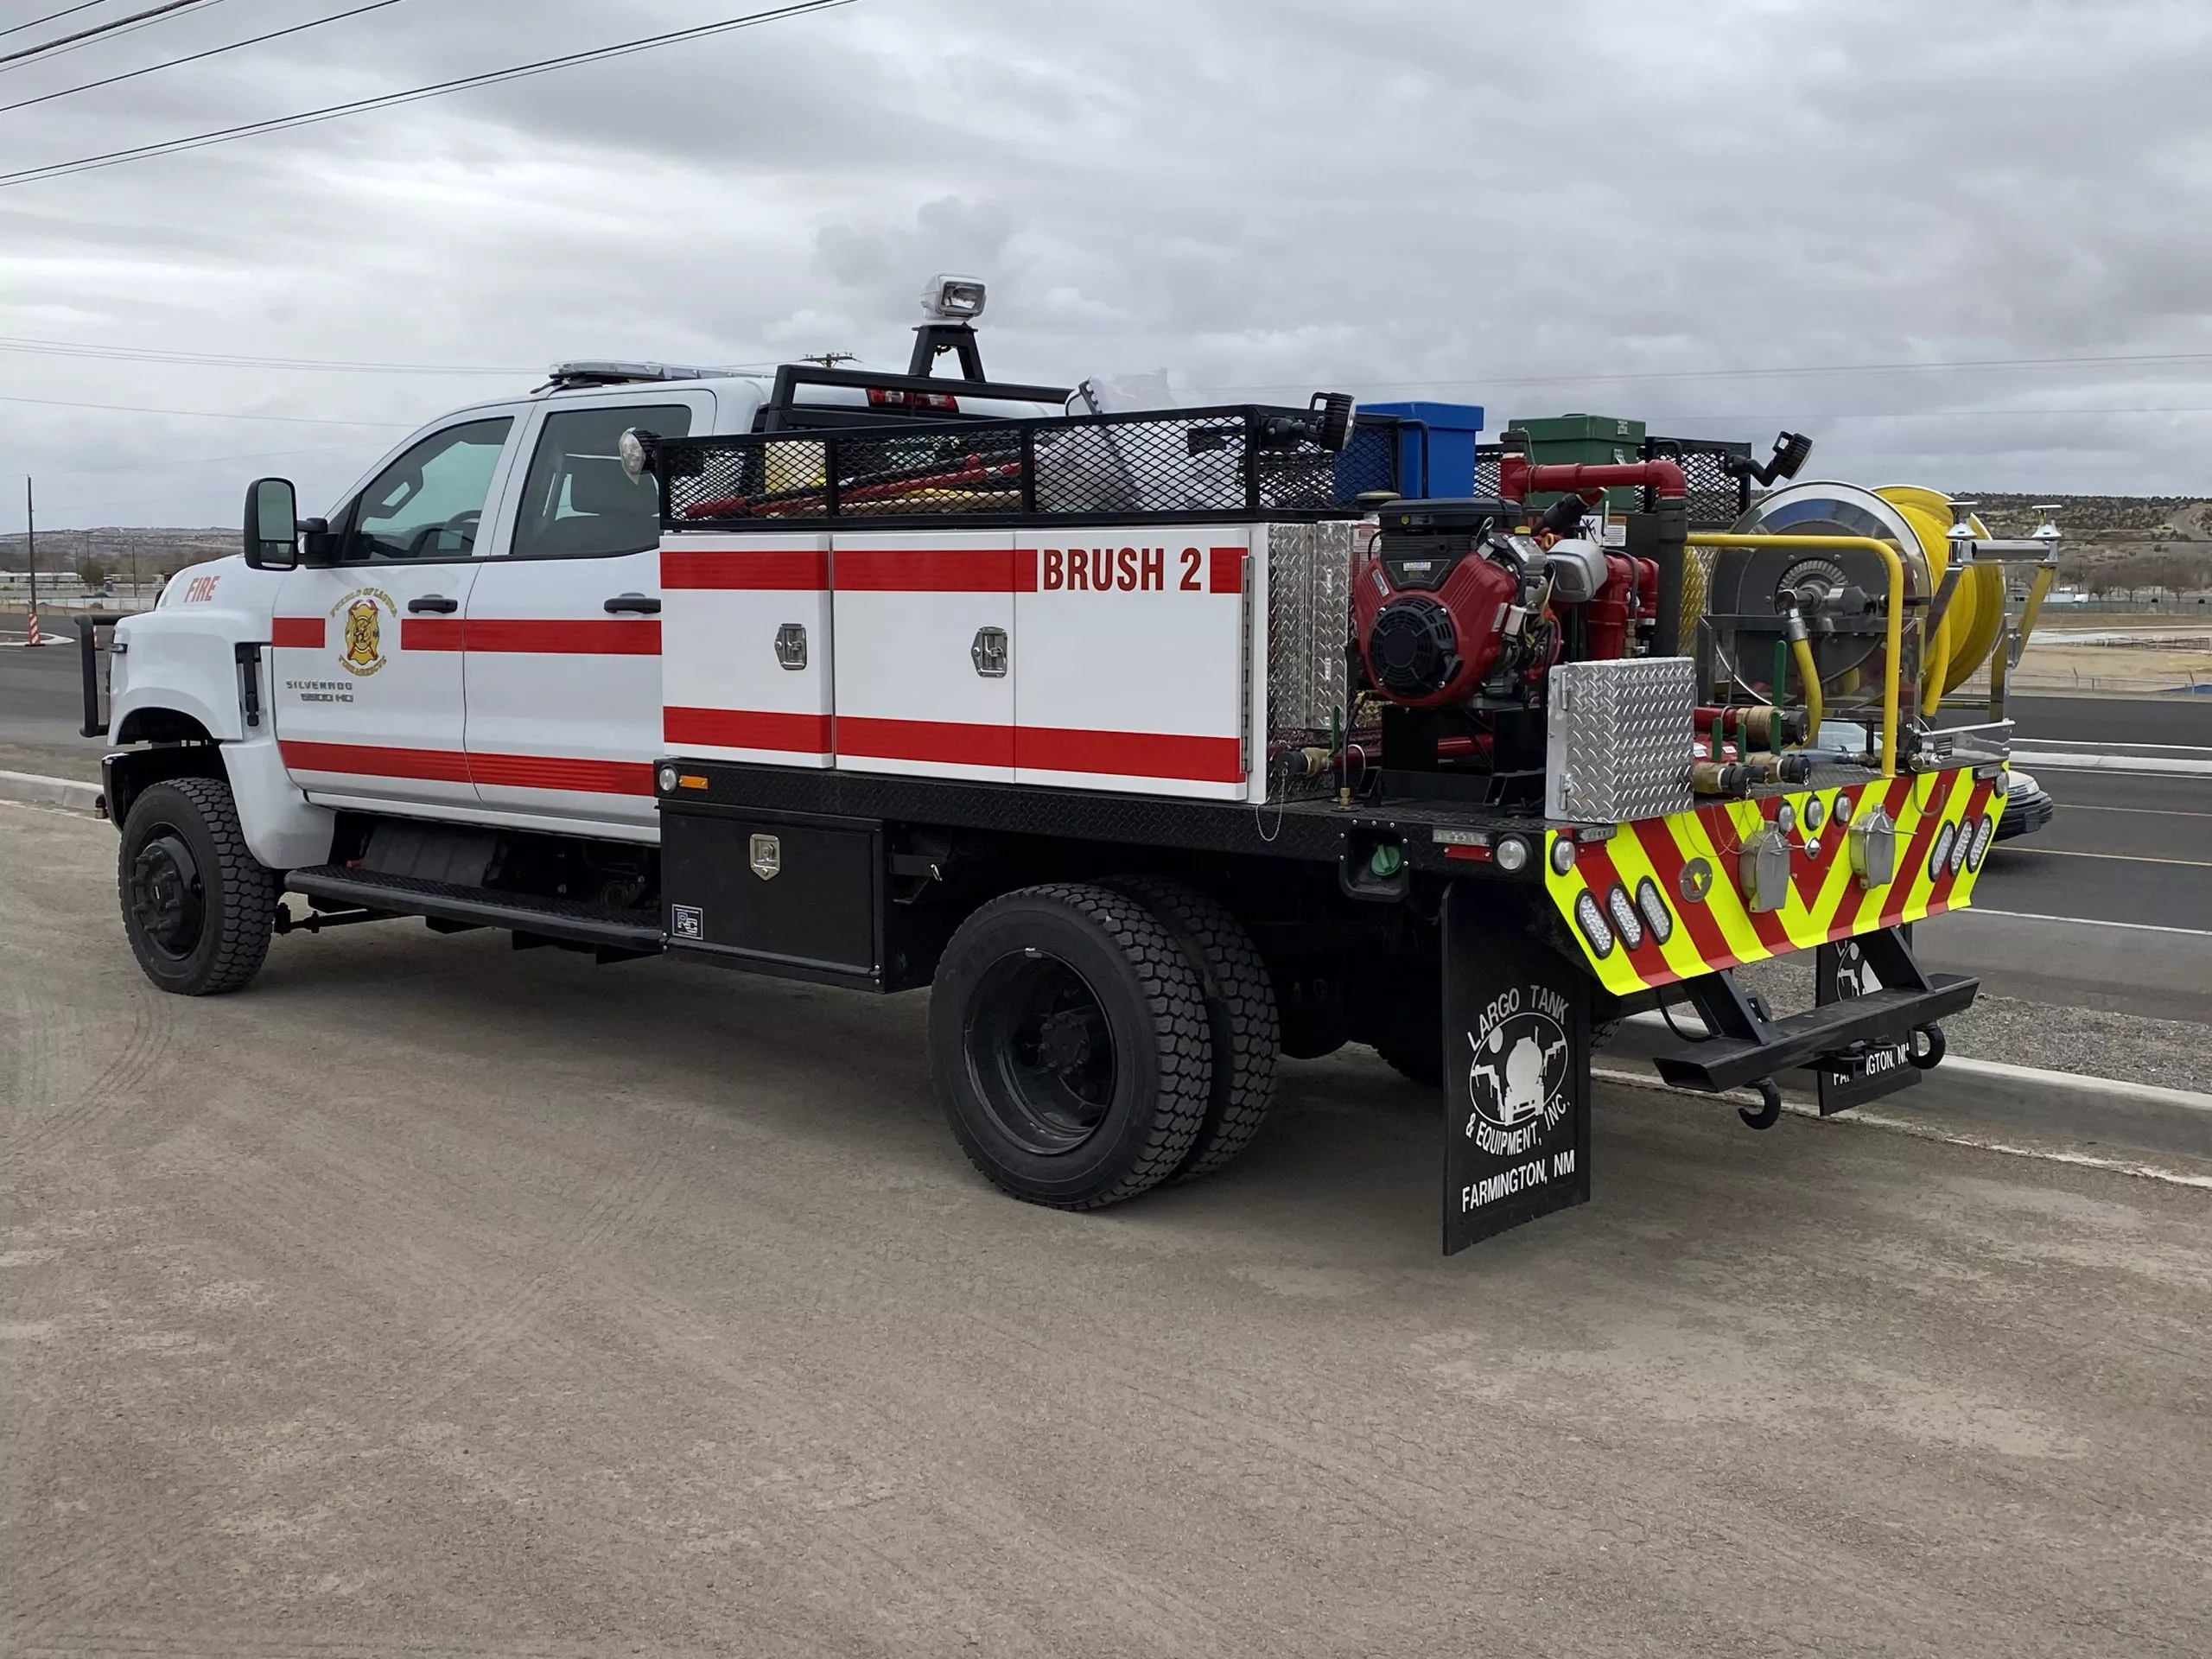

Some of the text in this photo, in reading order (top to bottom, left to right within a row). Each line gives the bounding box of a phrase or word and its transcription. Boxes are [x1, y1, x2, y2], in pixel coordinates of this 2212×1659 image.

[184, 575, 221, 603] FIRE
[1043, 547, 1202, 592] BRUSH 2
[285, 680, 353, 691] SILVERADO
[334, 694, 354, 702] HD
[1467, 984, 1570, 1052] LARGO TANK
[1465, 1093, 1571, 1156] & EQUIPMENT, INC.
[1461, 1149, 1575, 1213] FARMINGTON, NM
